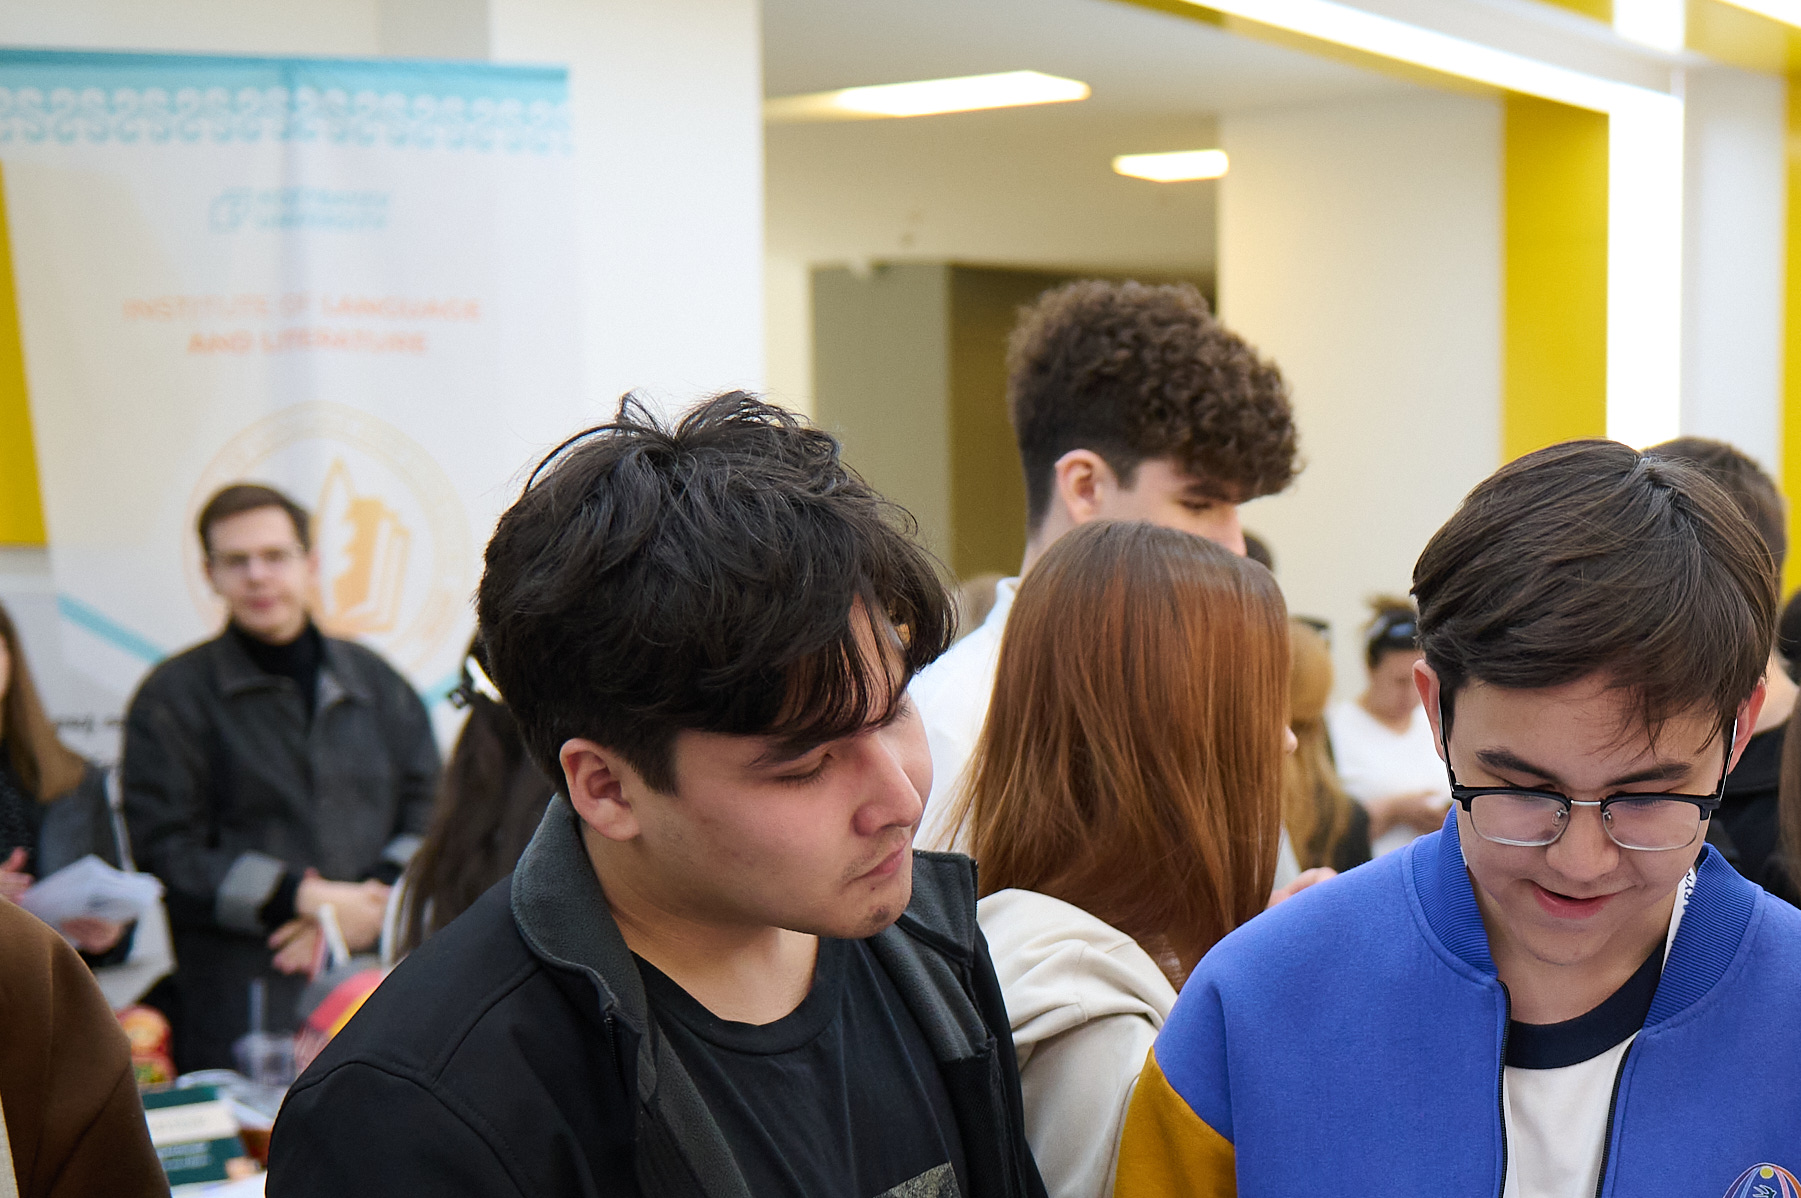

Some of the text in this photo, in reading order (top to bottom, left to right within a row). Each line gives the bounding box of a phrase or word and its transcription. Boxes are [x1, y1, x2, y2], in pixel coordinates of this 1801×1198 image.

[122, 294, 271, 321] INSTITUTE
[322, 295, 481, 321] LANGUAGE
[188, 329, 425, 355] AND LITERATURE
